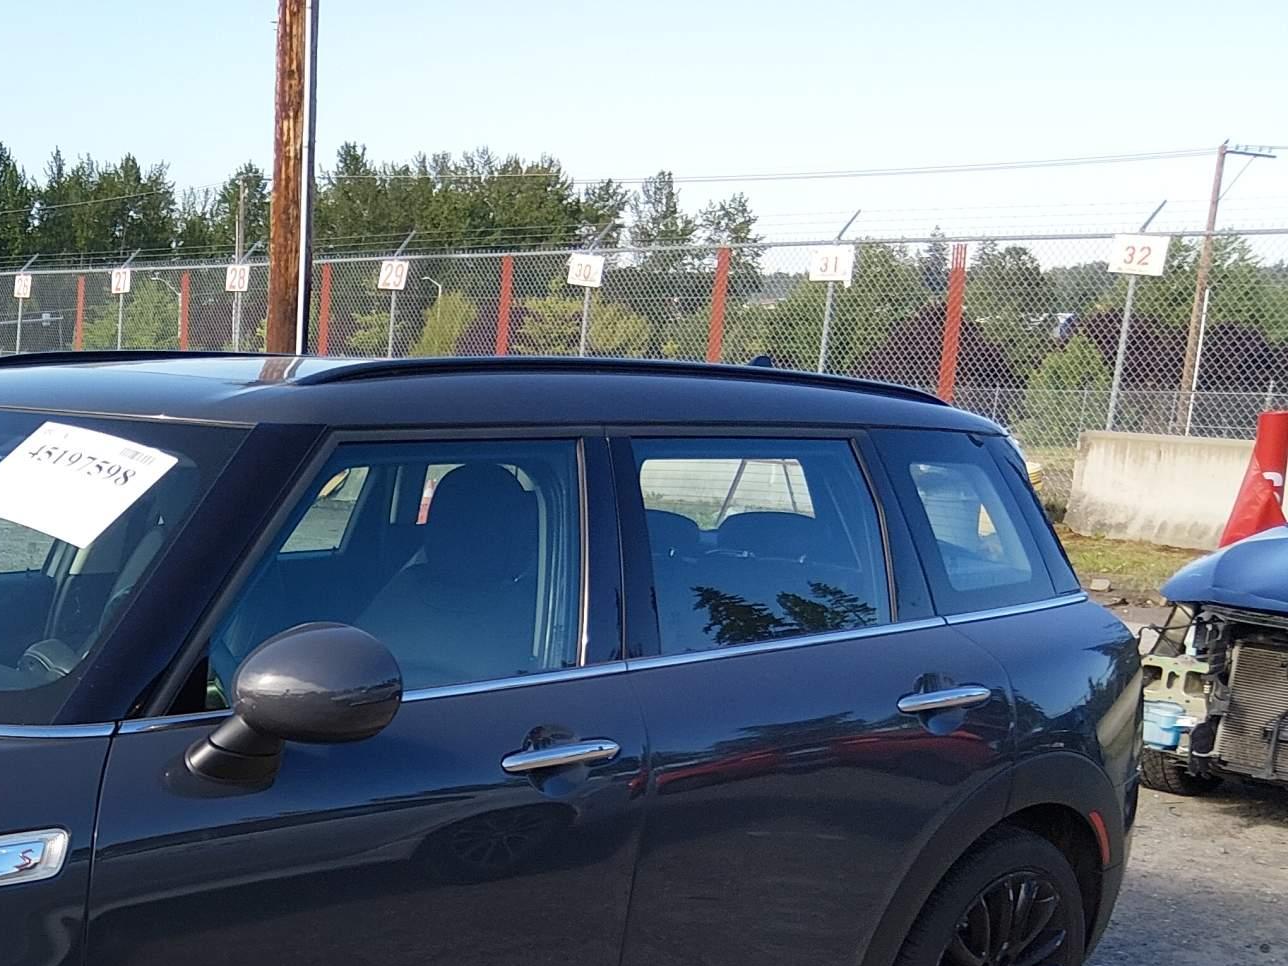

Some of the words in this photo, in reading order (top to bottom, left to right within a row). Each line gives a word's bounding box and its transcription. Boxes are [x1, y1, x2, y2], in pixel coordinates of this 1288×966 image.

[819, 255, 839, 273] 31
[1123, 245, 1152, 266] 32
[114, 271, 127, 292] 27
[228, 267, 246, 290] 28
[382, 262, 404, 287] 29
[574, 262, 592, 281] 30
[16, 277, 29, 296] 26
[28, 444, 136, 486] 45197598
